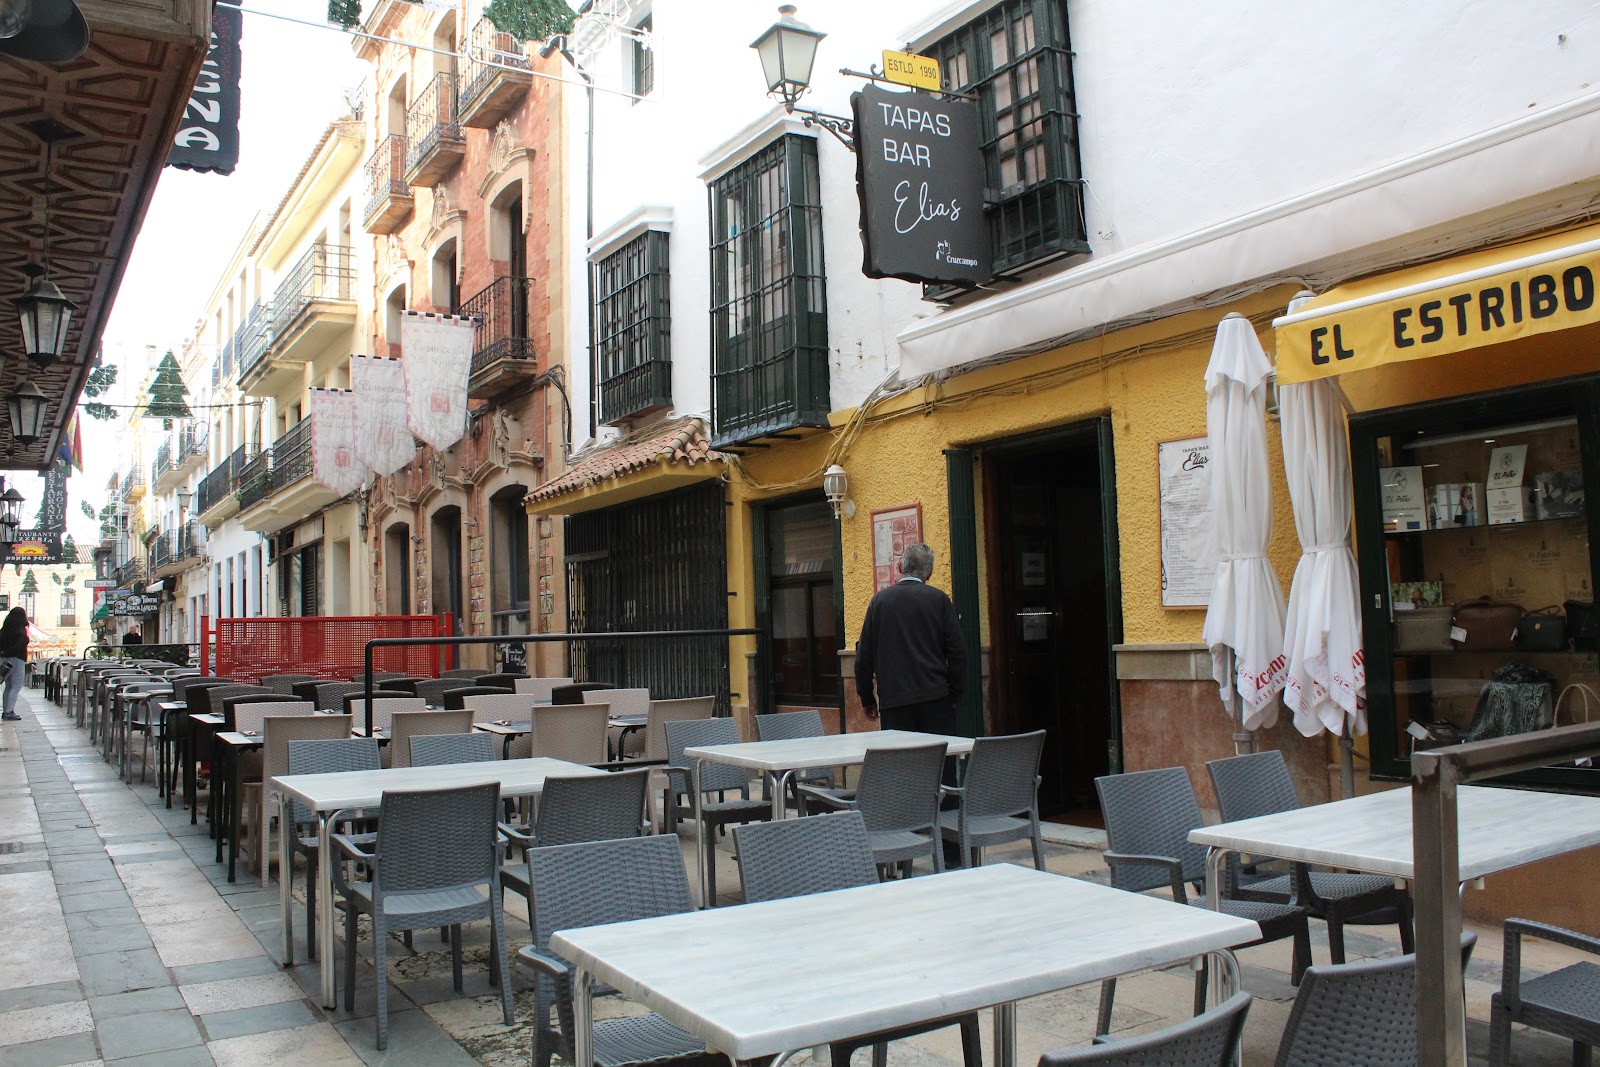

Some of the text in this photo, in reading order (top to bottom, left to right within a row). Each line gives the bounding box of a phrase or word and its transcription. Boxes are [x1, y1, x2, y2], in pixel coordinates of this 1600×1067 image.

[888, 58, 937, 80] ESTLD. 1990
[878, 102, 951, 137] TAPAS
[883, 138, 931, 168] BAR
[894, 180, 961, 234] Elias
[946, 255, 978, 267] Cruzcampo
[1310, 265, 1595, 366] EL ESTRIBO
[1182, 451, 1209, 471] Elias
